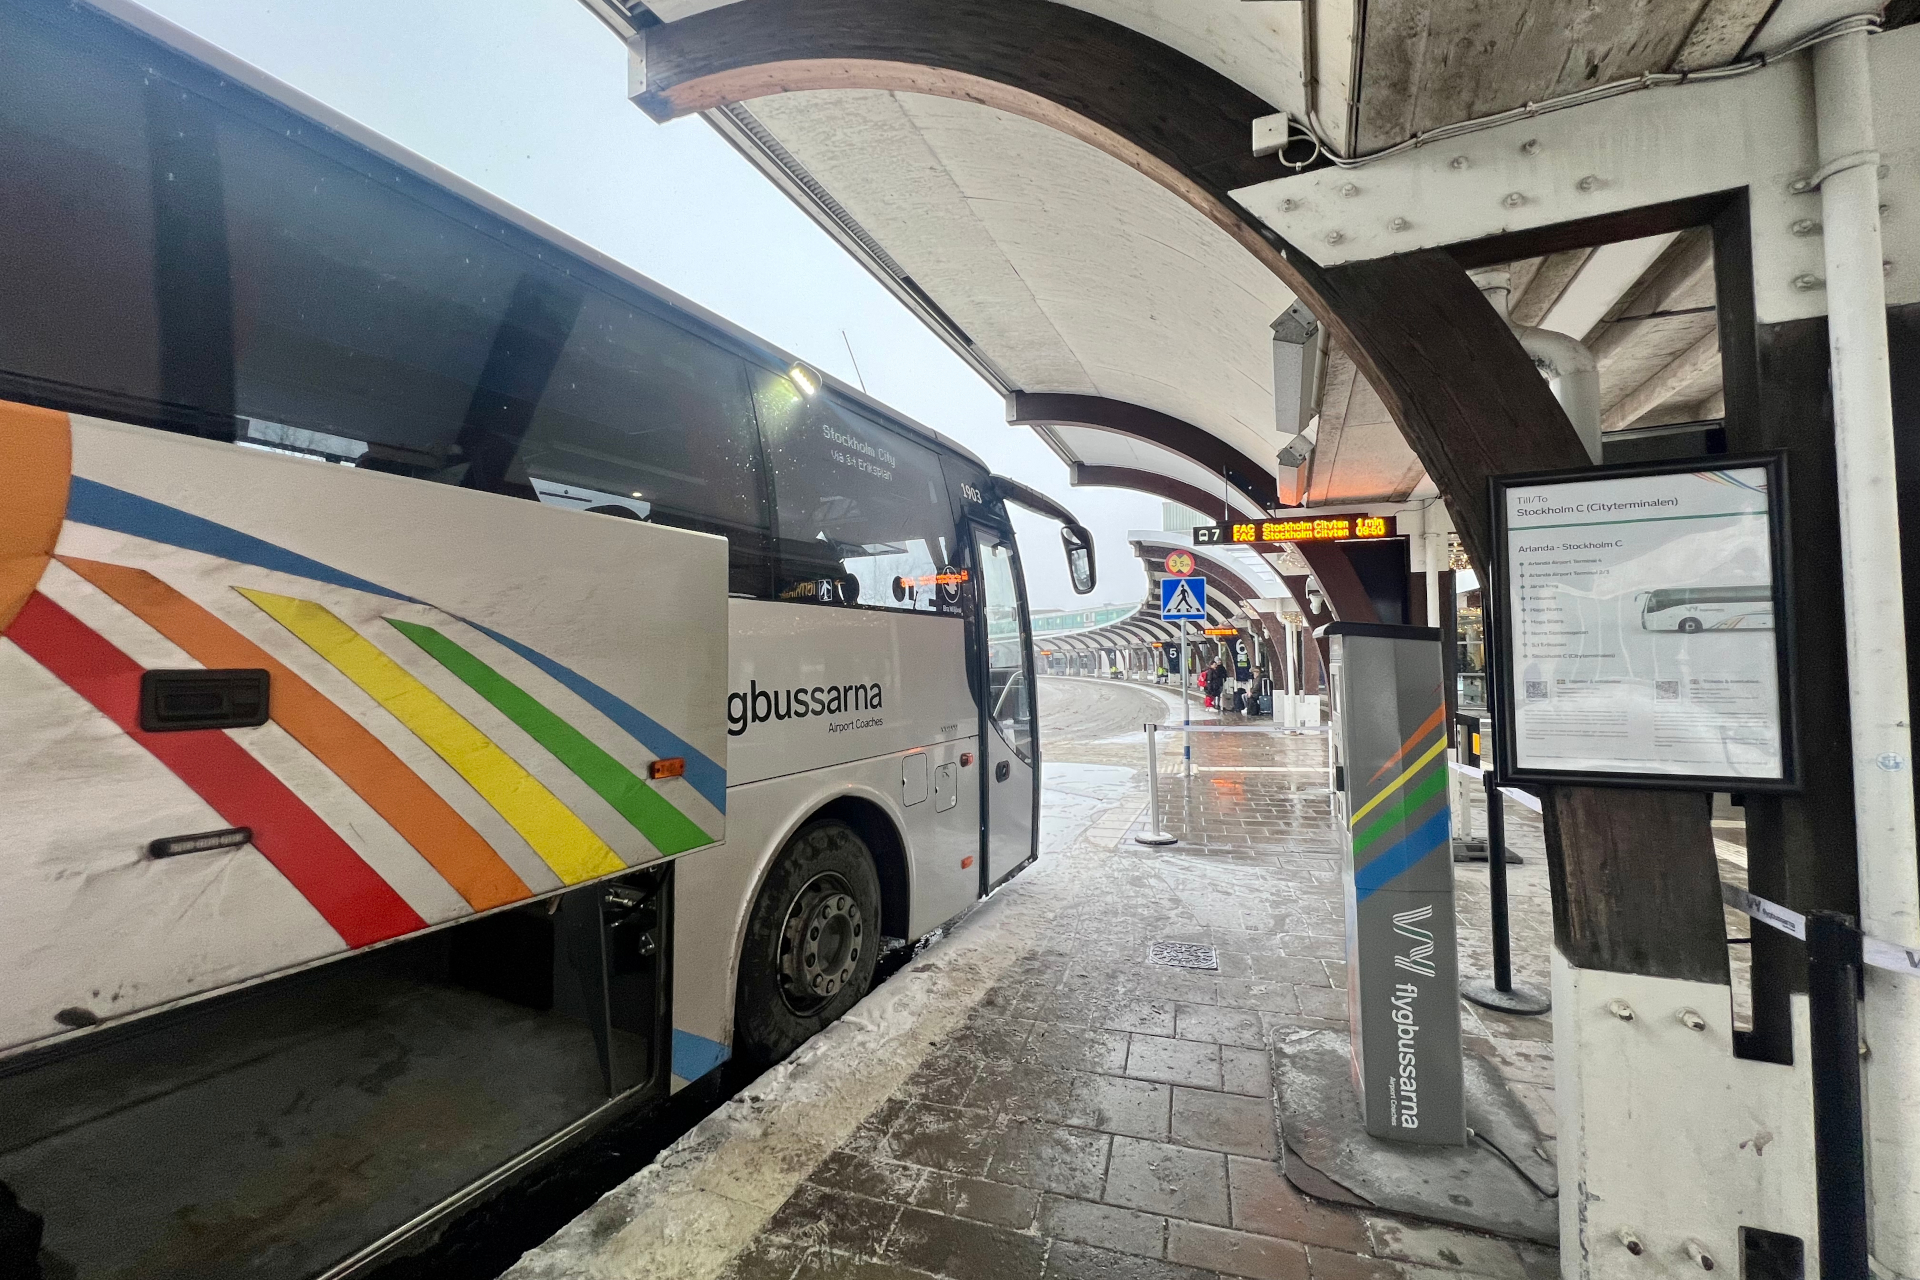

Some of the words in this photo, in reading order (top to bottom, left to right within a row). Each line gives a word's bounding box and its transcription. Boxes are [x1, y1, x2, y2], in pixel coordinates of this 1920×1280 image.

[822, 424, 876, 458] Stockholm
[878, 448, 896, 469] City
[960, 482, 983, 504] 1903
[1516, 505, 1574, 517] Stockholm
[1576, 504, 1584, 513] C
[1586, 497, 1679, 513] (Cityterminalen)
[1233, 524, 1255, 533] FAC
[1262, 521, 1313, 532] Stockholm
[1364, 517, 1384, 526] min
[1233, 532, 1255, 542] FAC
[1262, 529, 1313, 541] Stockholm
[1356, 525, 1385, 537] 09:50
[1211, 529, 1220, 541] 7
[1518, 544, 1555, 553] Arlanda
[1562, 541, 1613, 551] Stockholm
[1615, 539, 1623, 547] C
[1169, 648, 1177, 658] 5
[1235, 638, 1248, 655] 6
[828, 721, 854, 733] Airport
[855, 717, 883, 728] Coaches
[1391, 982, 1420, 1129] flygbussarna
